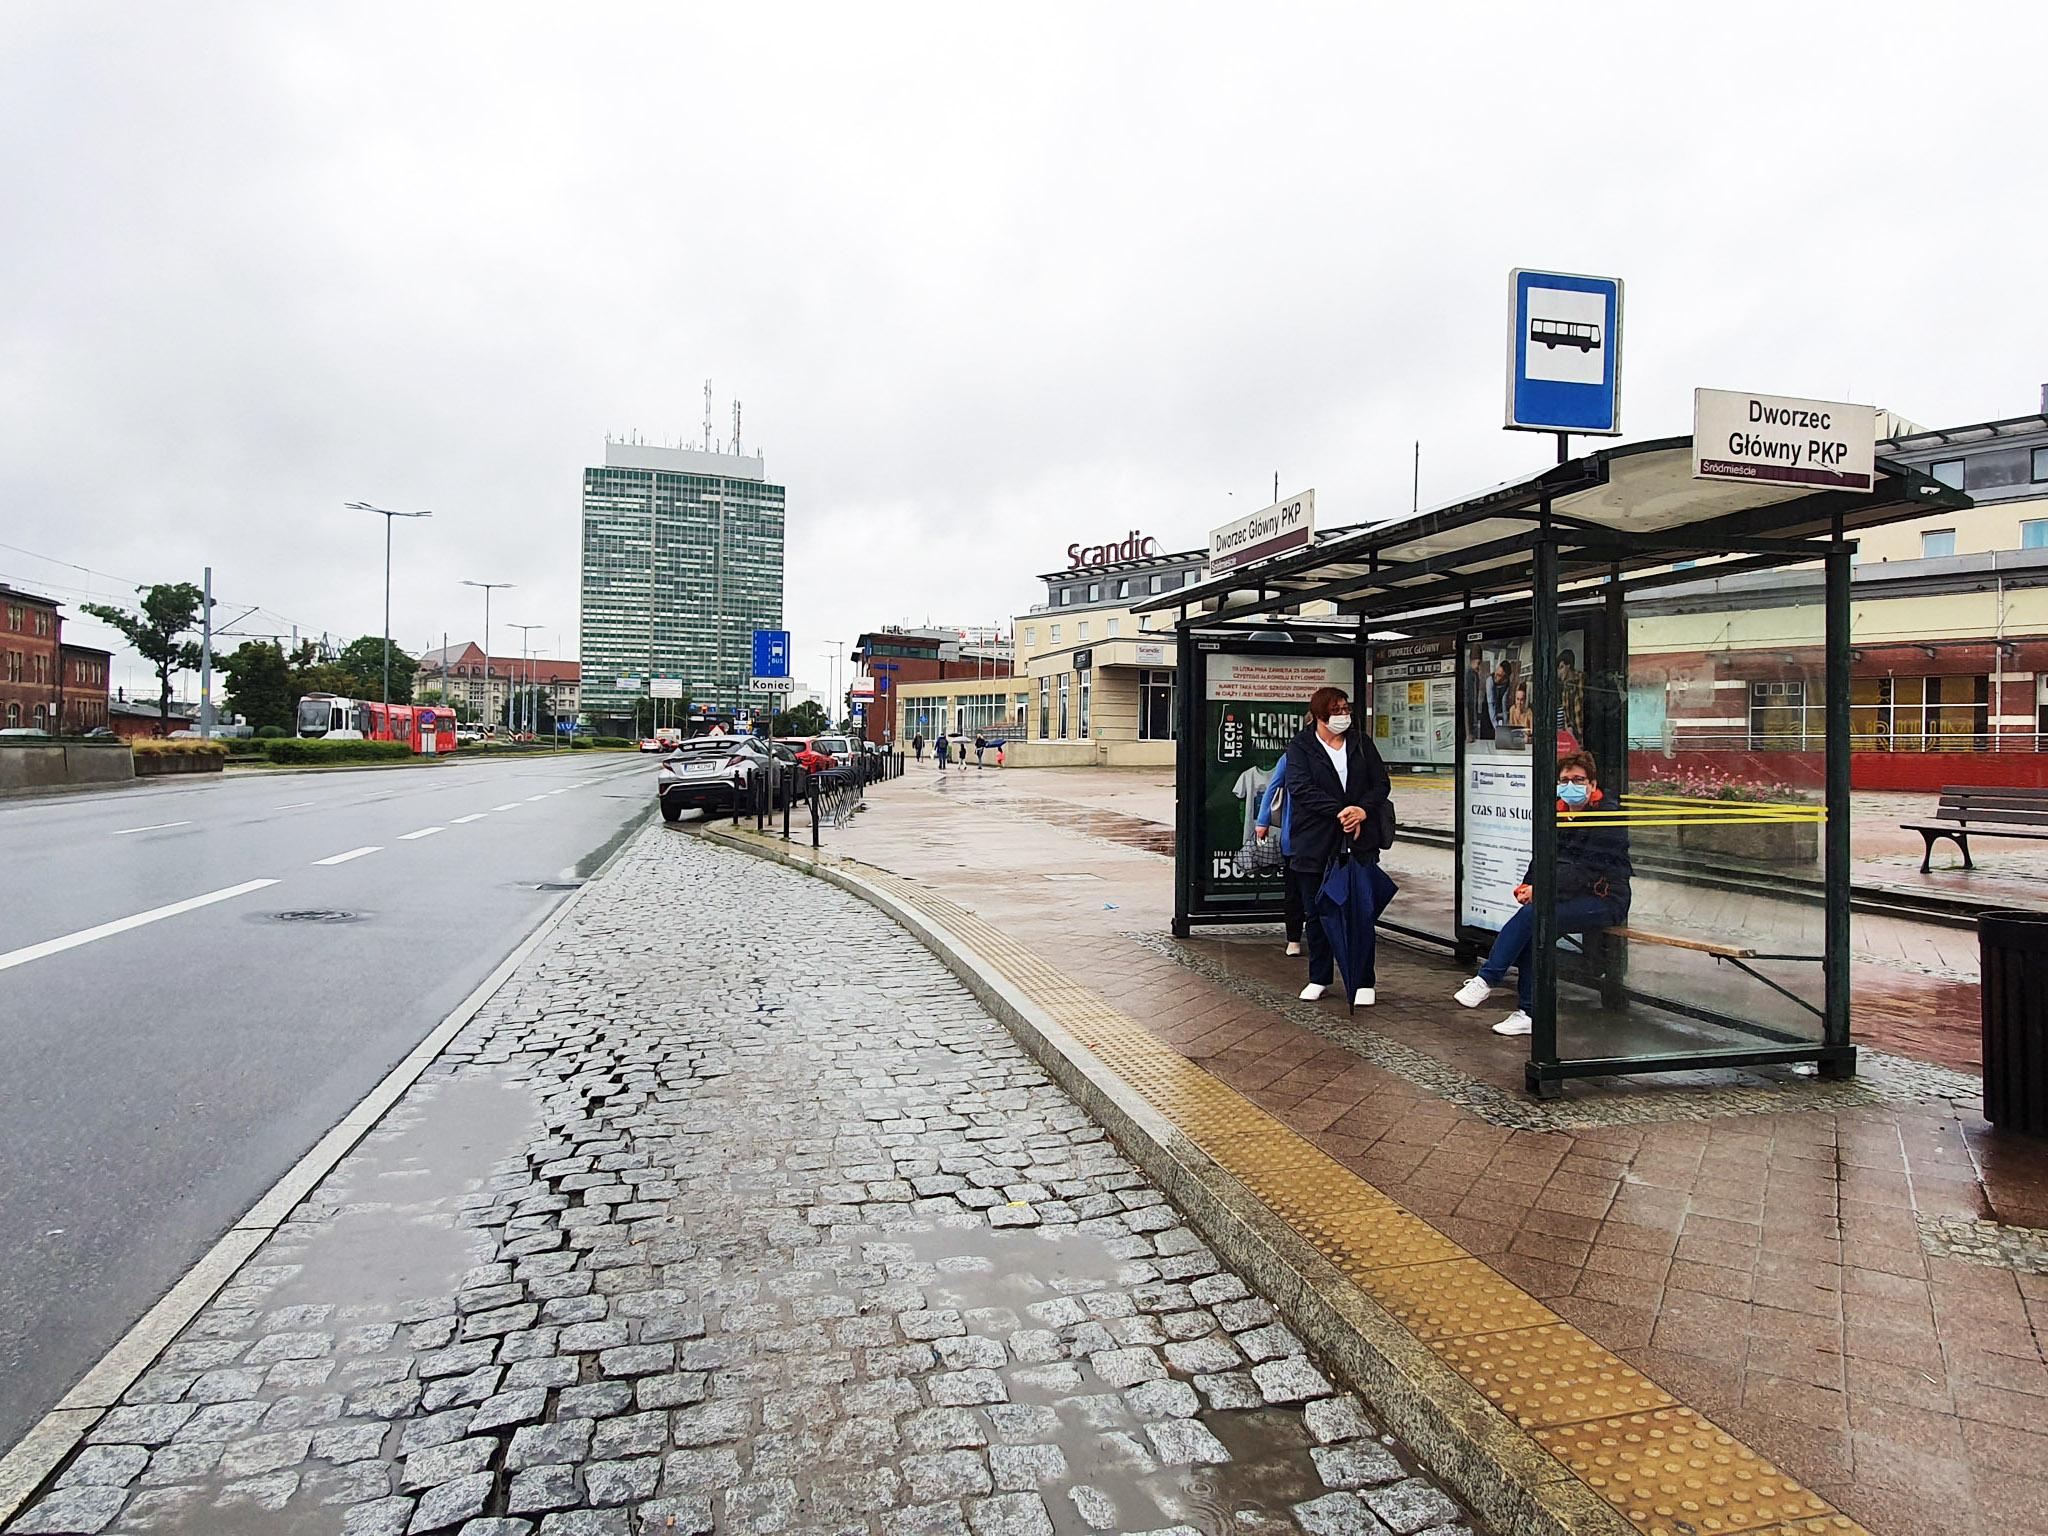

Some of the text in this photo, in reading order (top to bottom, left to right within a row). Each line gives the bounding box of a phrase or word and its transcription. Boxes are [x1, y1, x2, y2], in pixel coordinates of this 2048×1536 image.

[1750, 400, 1831, 430] Dworzec
[1729, 432, 1848, 466] Główny PKP
[1702, 458, 1756, 476] Śródmieście
[1216, 502, 1301, 553] Dworzec Główny PKP
[1068, 530, 1154, 570] Scandic
[753, 680, 790, 690] Koniec
[1224, 722, 1236, 757] LECH
[1471, 804, 1492, 816] czas
[1496, 806, 1507, 817] na
